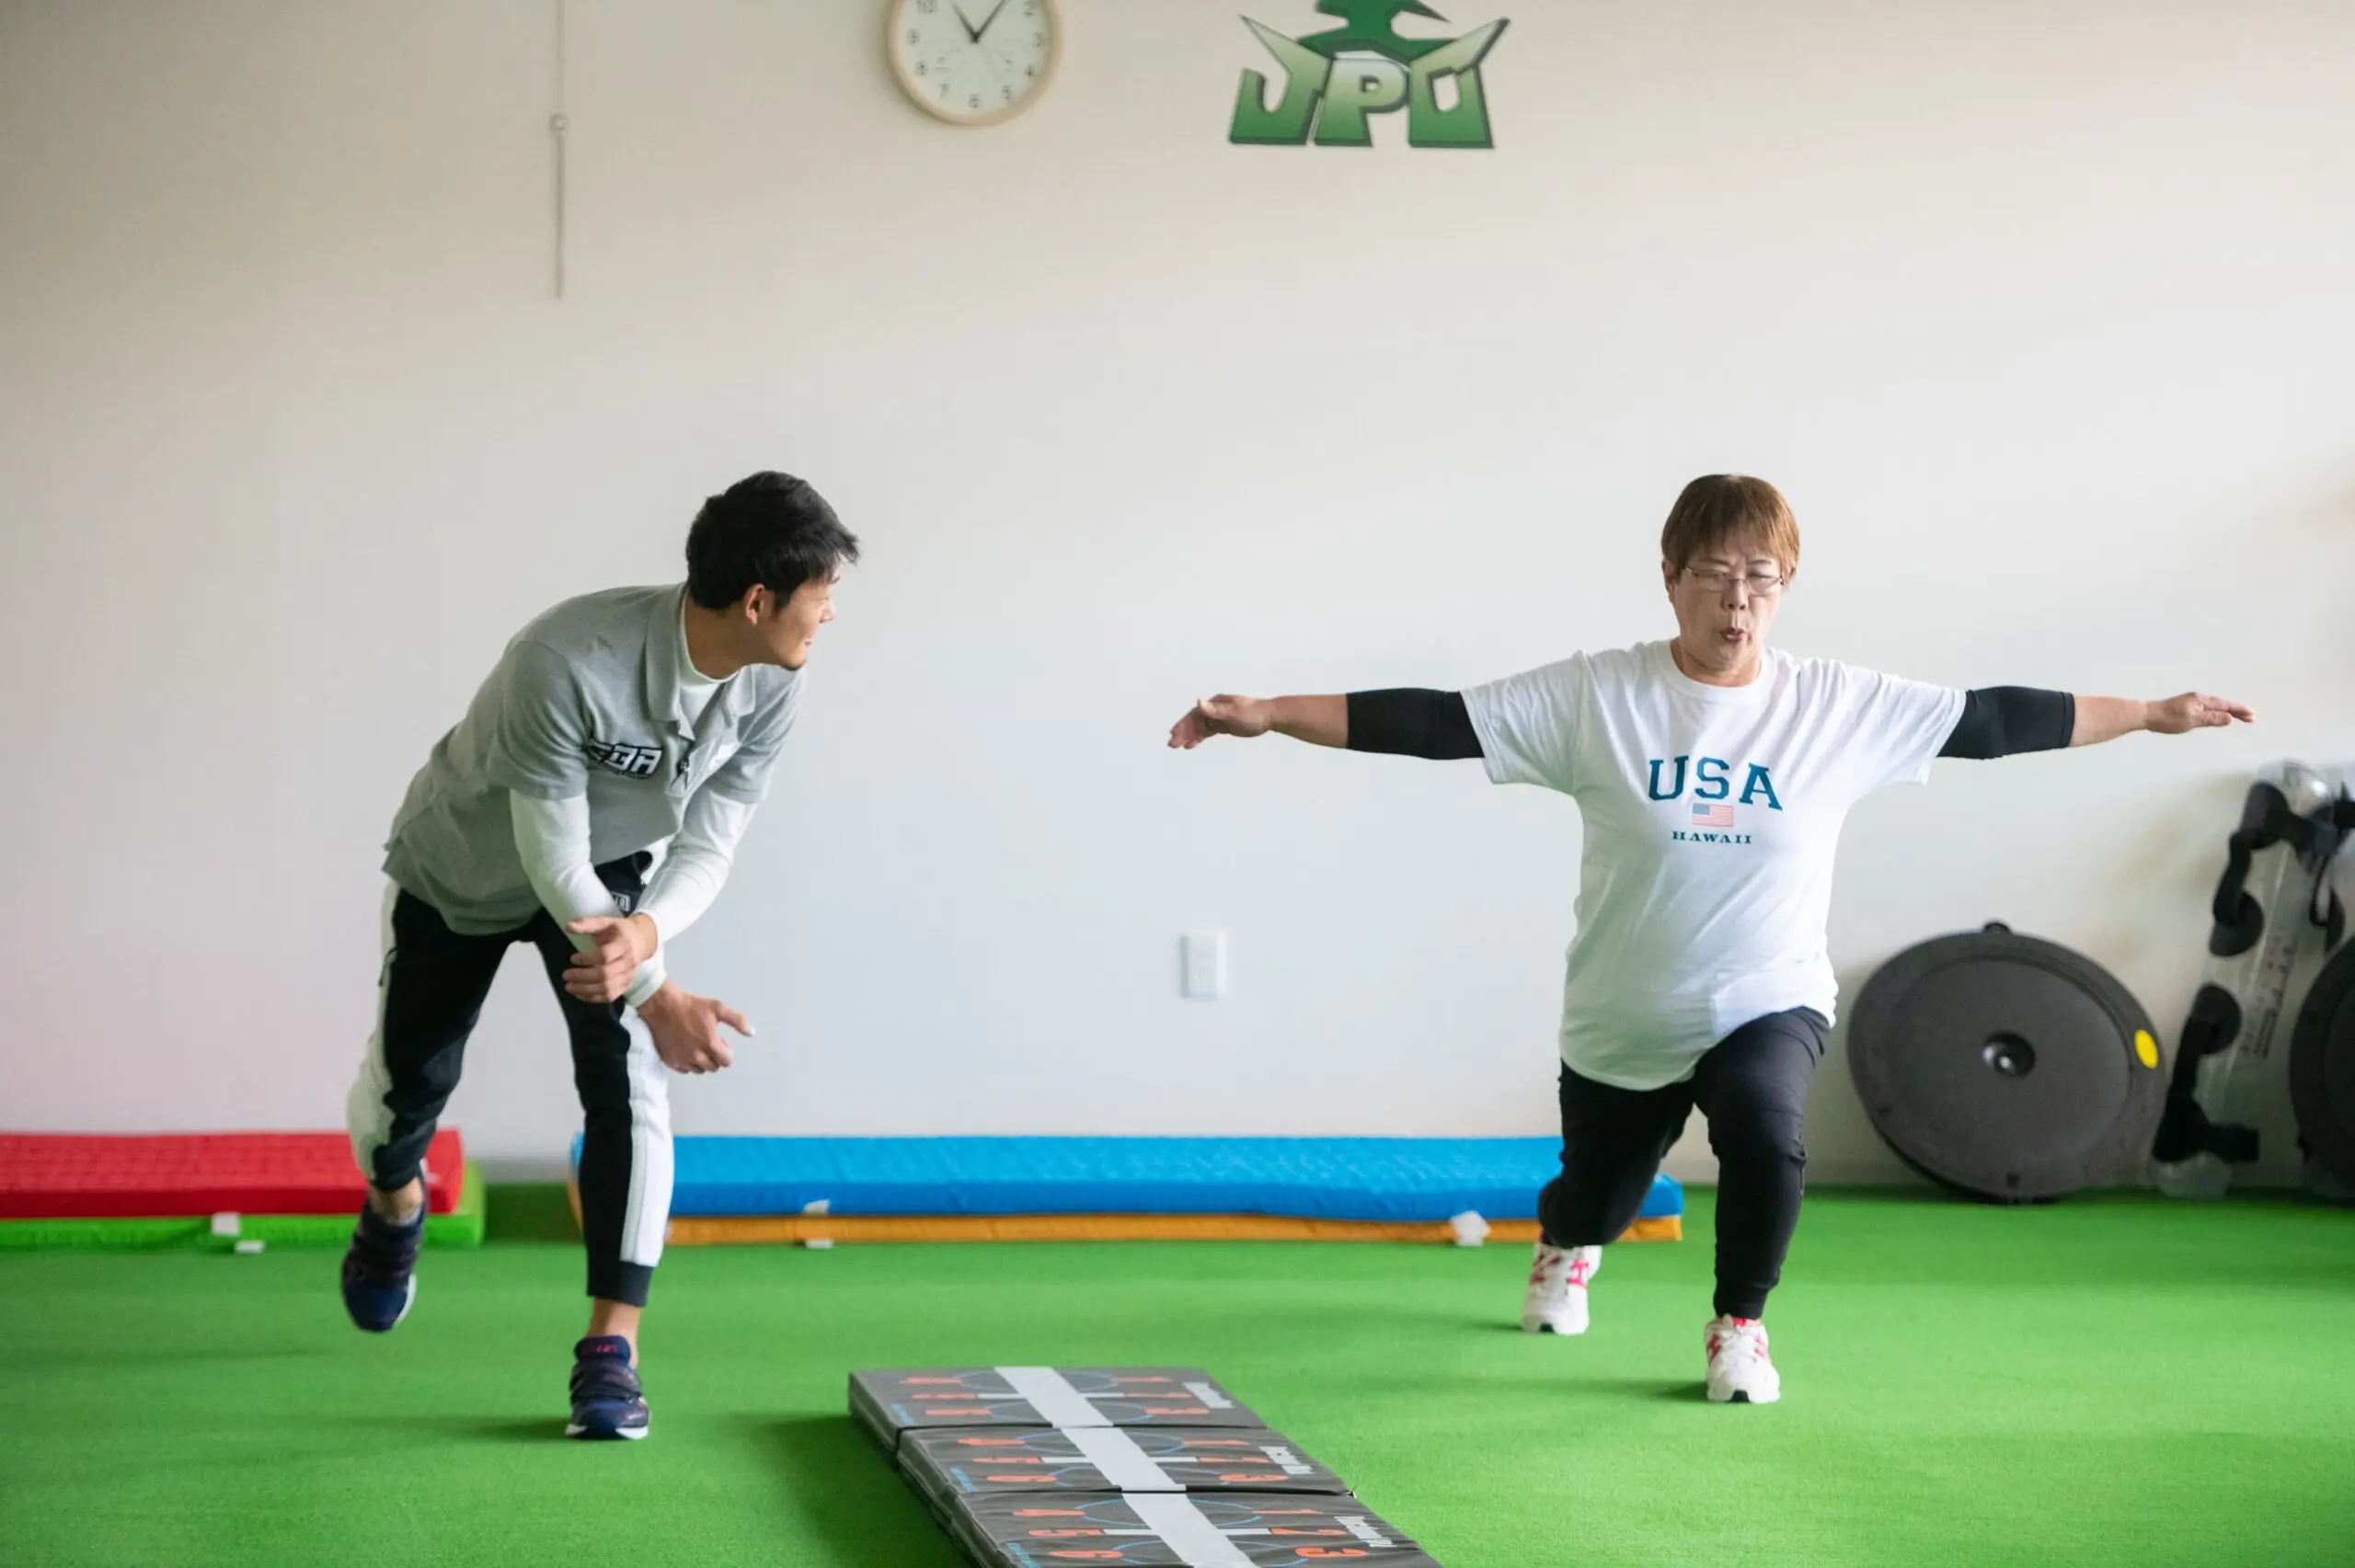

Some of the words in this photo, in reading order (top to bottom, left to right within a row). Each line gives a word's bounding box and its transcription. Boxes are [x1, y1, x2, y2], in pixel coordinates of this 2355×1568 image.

[1648, 755, 1783, 811] USA
[1671, 830, 1752, 844] HAWAII
[1295, 1546, 1370, 1559] 3
